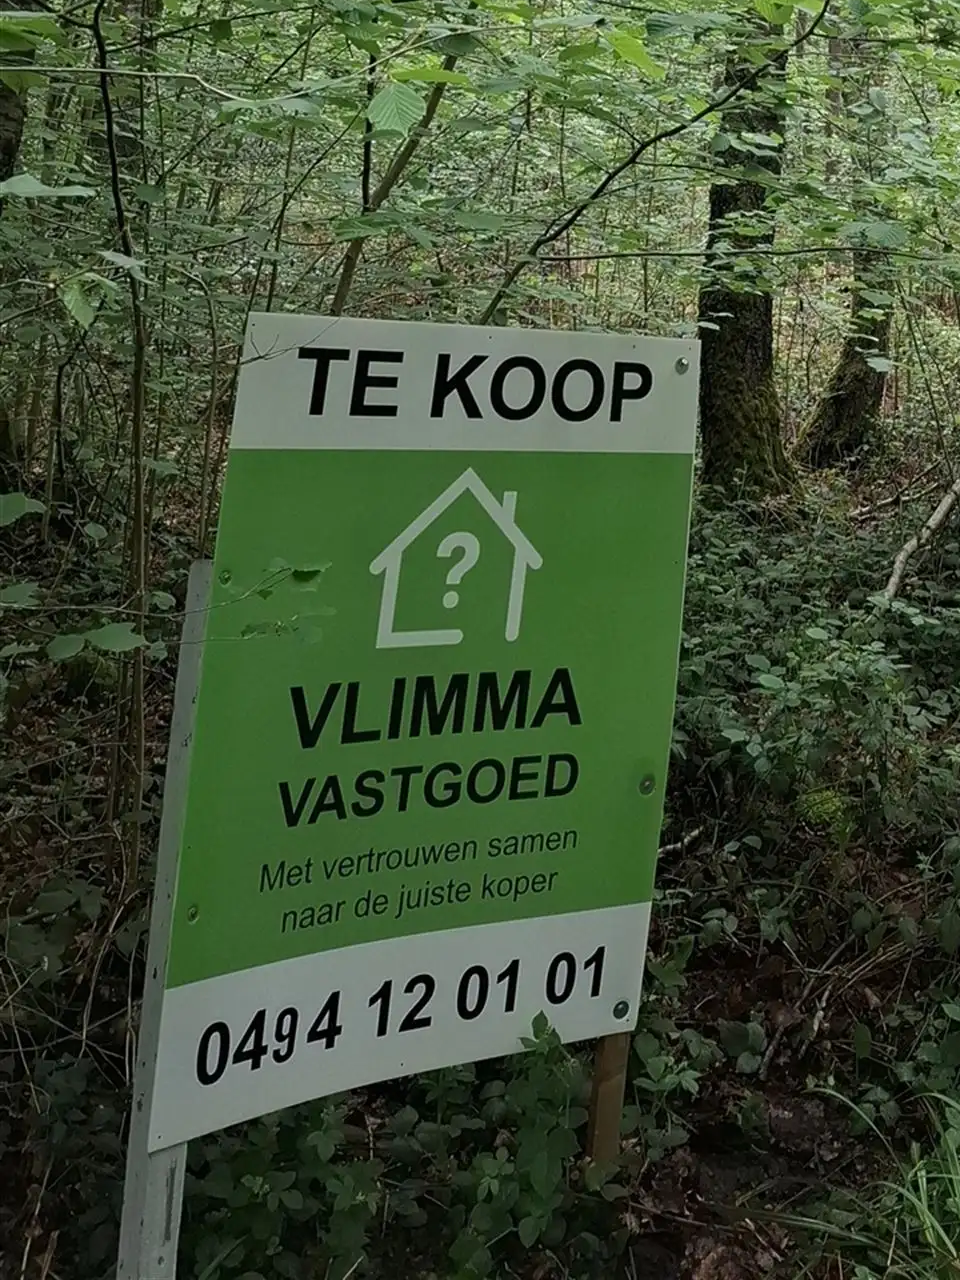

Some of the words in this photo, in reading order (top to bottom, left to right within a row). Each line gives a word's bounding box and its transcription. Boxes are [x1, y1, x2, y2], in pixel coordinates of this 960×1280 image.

[297, 346, 404, 417] TE
[430, 353, 653, 422] KOOP
[289, 667, 582, 749] VLIMMA
[278, 753, 579, 828] VASTGOED
[259, 858, 313, 893] Met
[322, 840, 477, 880] vertrouwen
[487, 830, 578, 858] samen
[281, 900, 347, 933] naar
[354, 889, 389, 918] de
[394, 880, 471, 918] juiste
[481, 871, 559, 902] koper
[196, 990, 343, 1086] 0494
[368, 973, 436, 1037] 12
[456, 958, 520, 1021] 01
[546, 945, 606, 1005] 01
